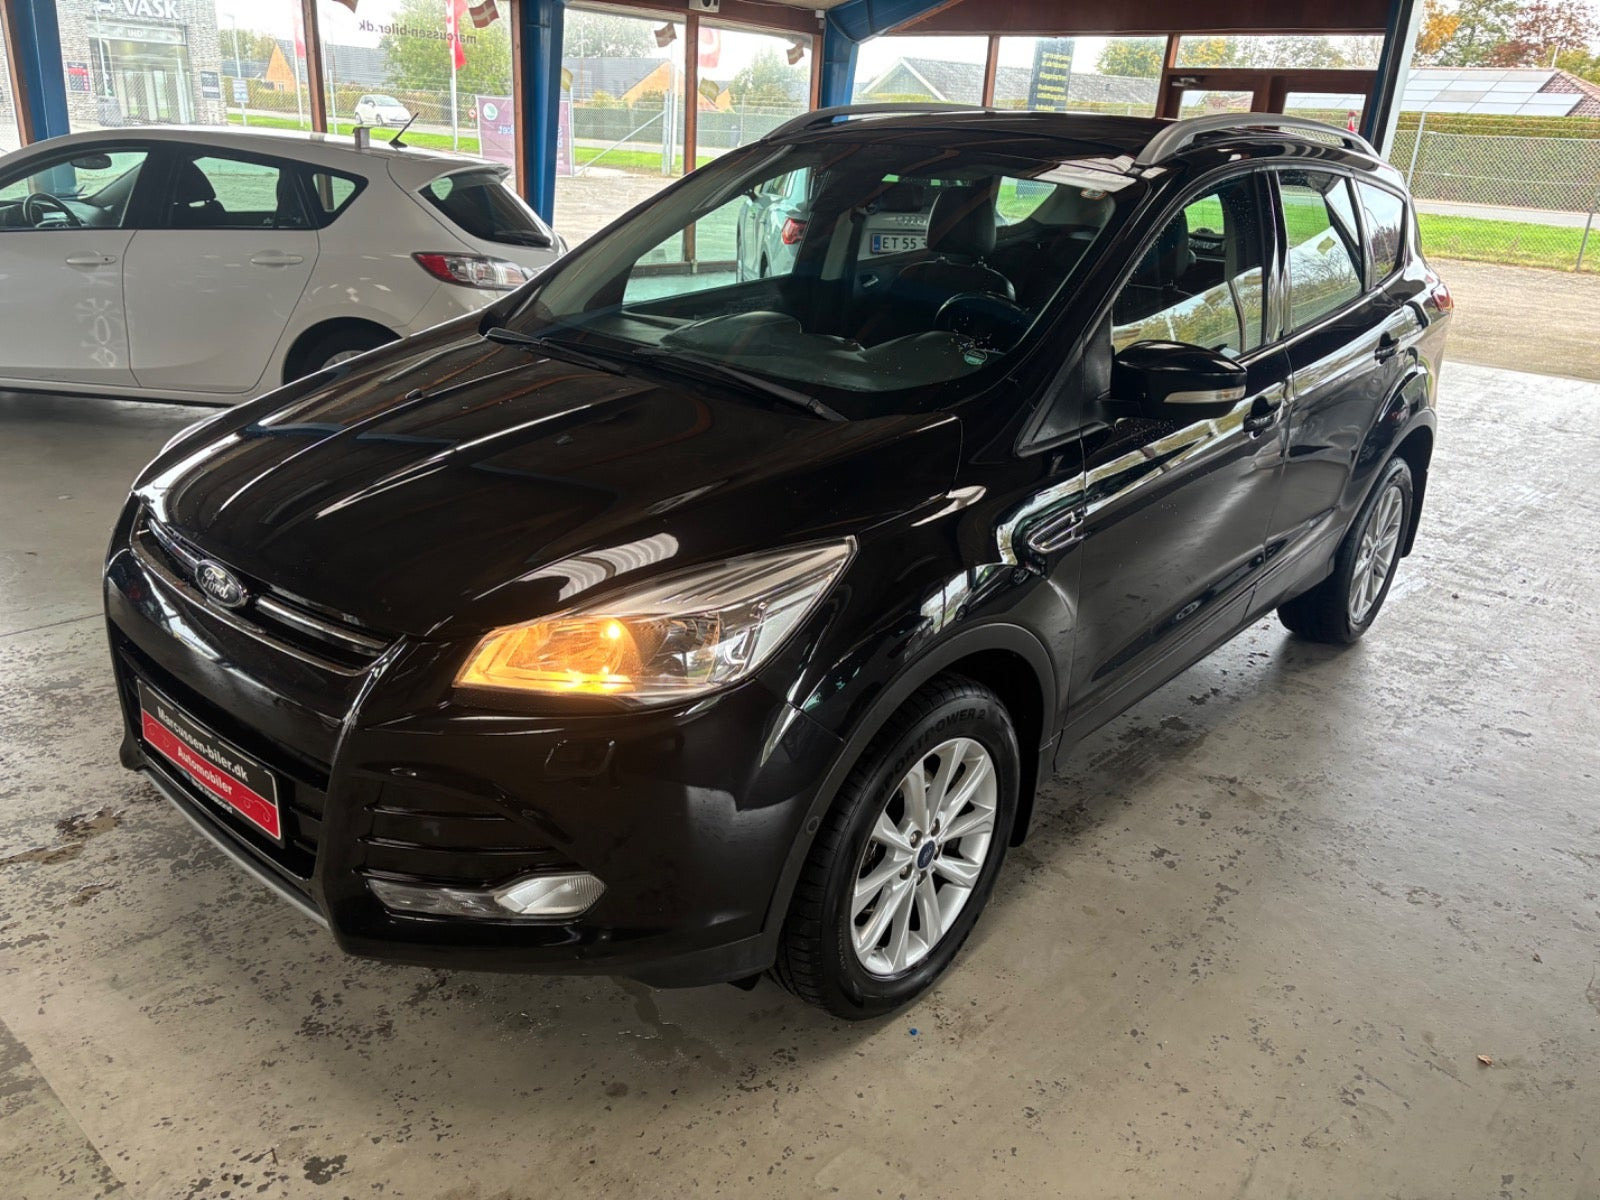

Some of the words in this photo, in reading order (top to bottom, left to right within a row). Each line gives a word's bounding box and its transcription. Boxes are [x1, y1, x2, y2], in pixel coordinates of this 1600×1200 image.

[123, 0, 180, 19] VASK
[882, 237, 898, 249] ET
[902, 237, 917, 250] 55
[202, 567, 229, 599] Ford
[977, 708, 986, 720] 2
[157, 706, 249, 782] Marcussen-biler.dk
[177, 746, 232, 795] Automobiler
